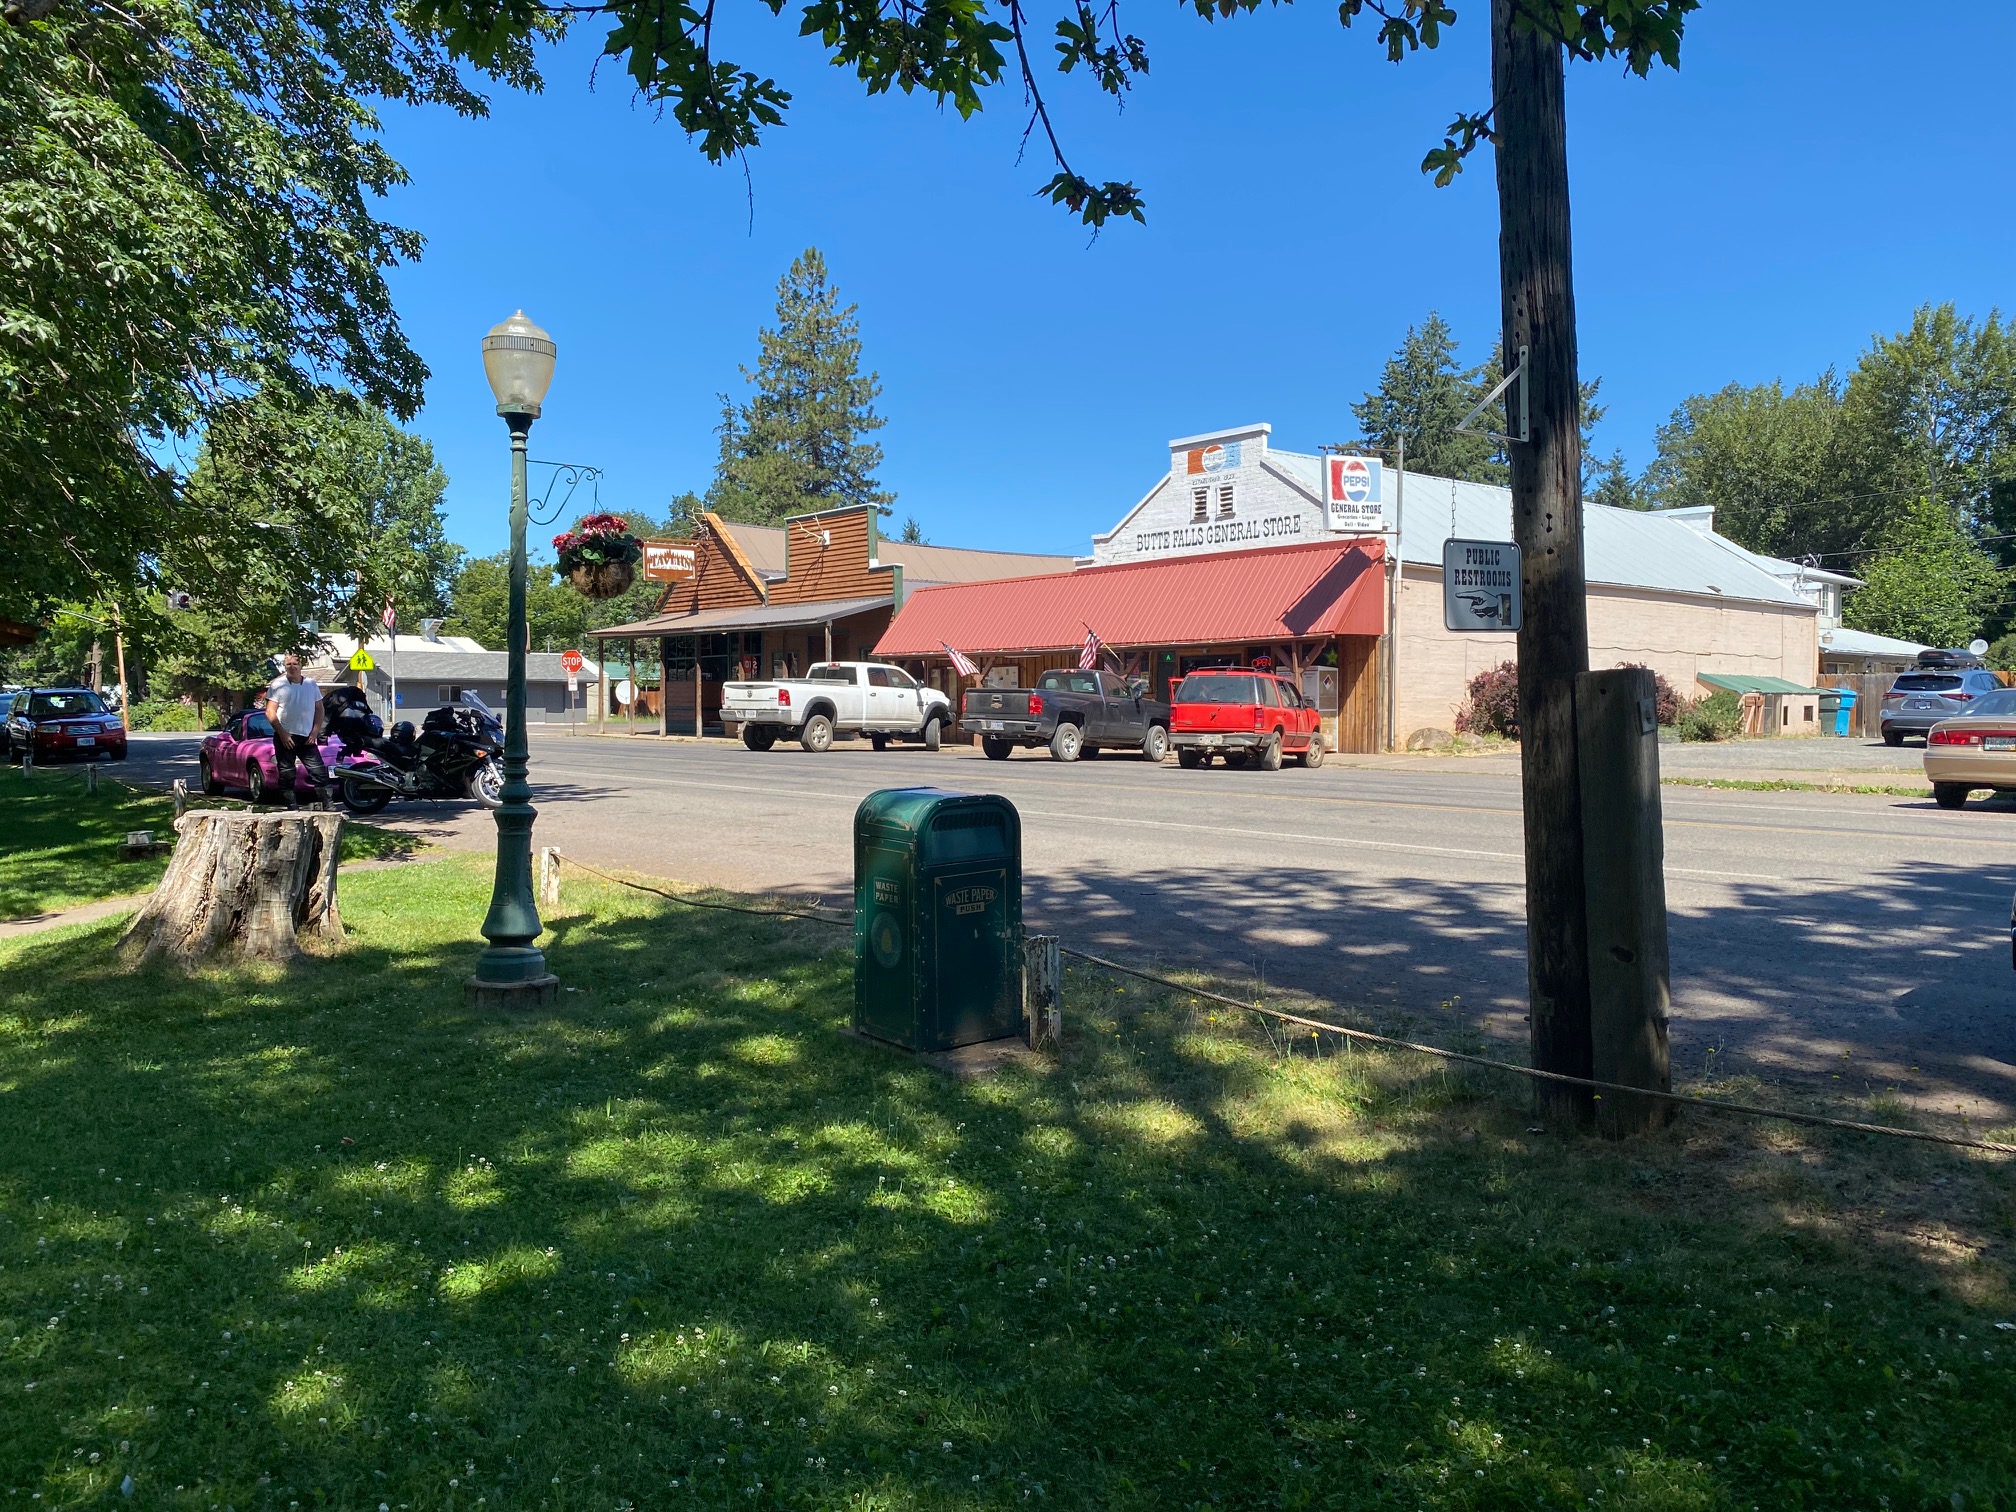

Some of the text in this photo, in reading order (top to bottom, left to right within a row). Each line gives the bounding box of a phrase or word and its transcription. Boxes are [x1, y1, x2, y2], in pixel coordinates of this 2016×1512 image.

[1343, 475, 1370, 487] PEPSI
[1331, 503, 1382, 514] GENERAL STORE
[1136, 514, 1301, 551] BUTTE FALLS GENERAL STORE
[1466, 548, 1500, 566] PUBLIC
[1454, 569, 1512, 587] RESTROOMS
[562, 656, 582, 666] STOP
[875, 881, 899, 893] WASTE
[875, 891, 899, 904] PAPER
[945, 887, 995, 906] WASTE PAPER
[960, 904, 982, 912] PUSH
